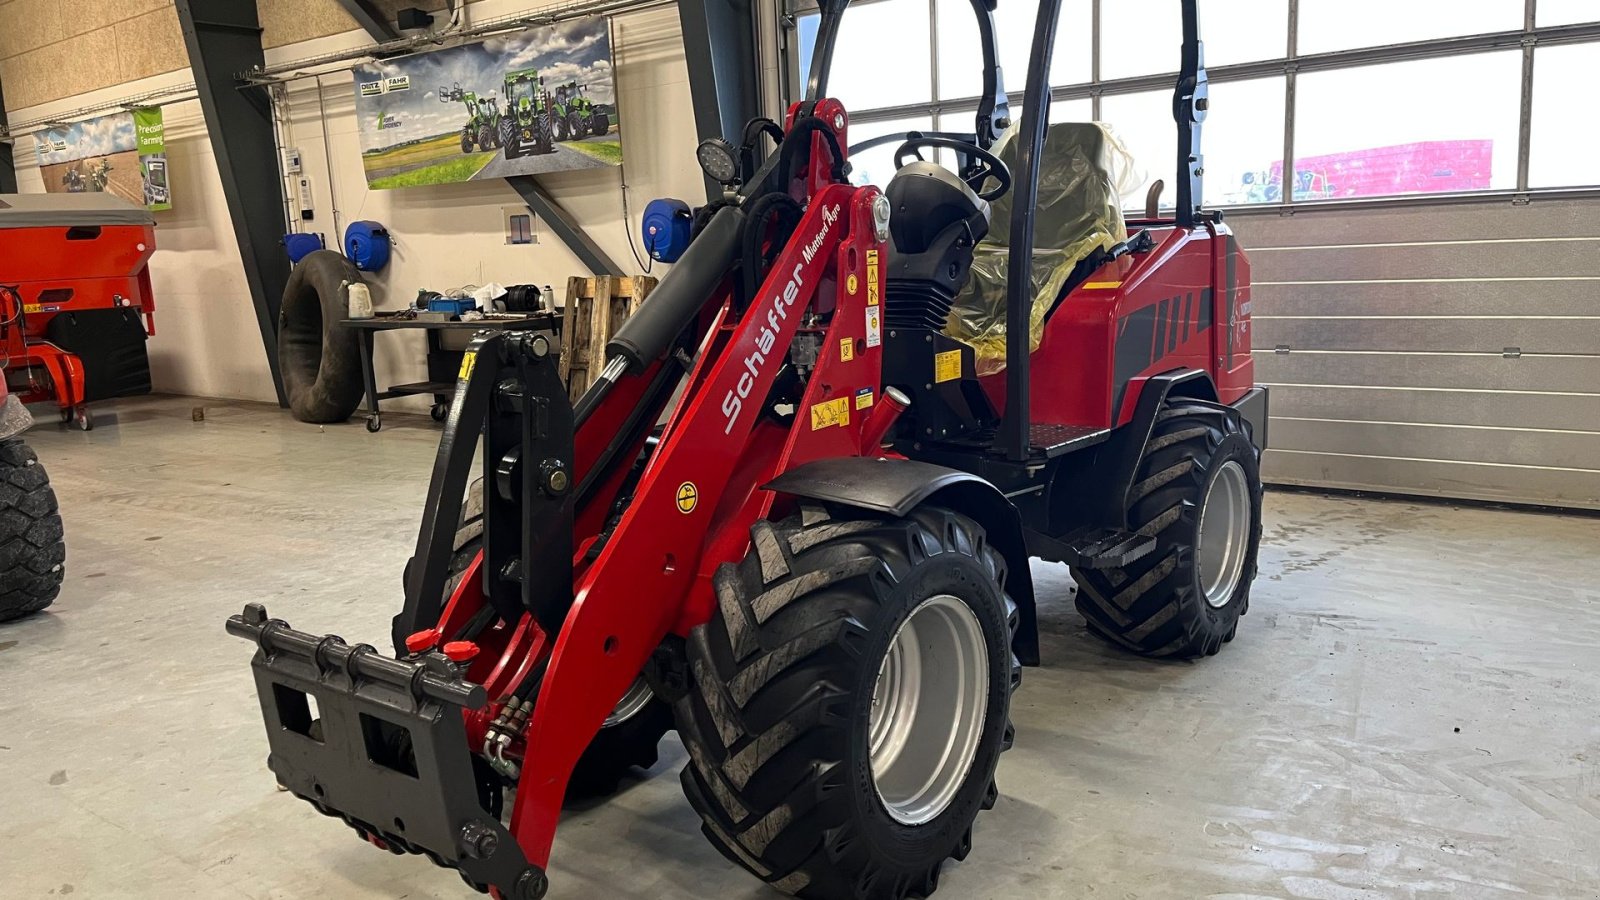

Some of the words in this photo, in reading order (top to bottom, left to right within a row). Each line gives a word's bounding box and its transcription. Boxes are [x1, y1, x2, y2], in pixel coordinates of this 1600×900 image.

[389, 77, 406, 85] FAHR
[138, 123, 163, 134] Precision
[140, 135, 164, 146] Farming
[721, 262, 804, 435] Schäffer
[802, 221, 829, 265] Midtfjord
[825, 203, 841, 227] Agro
